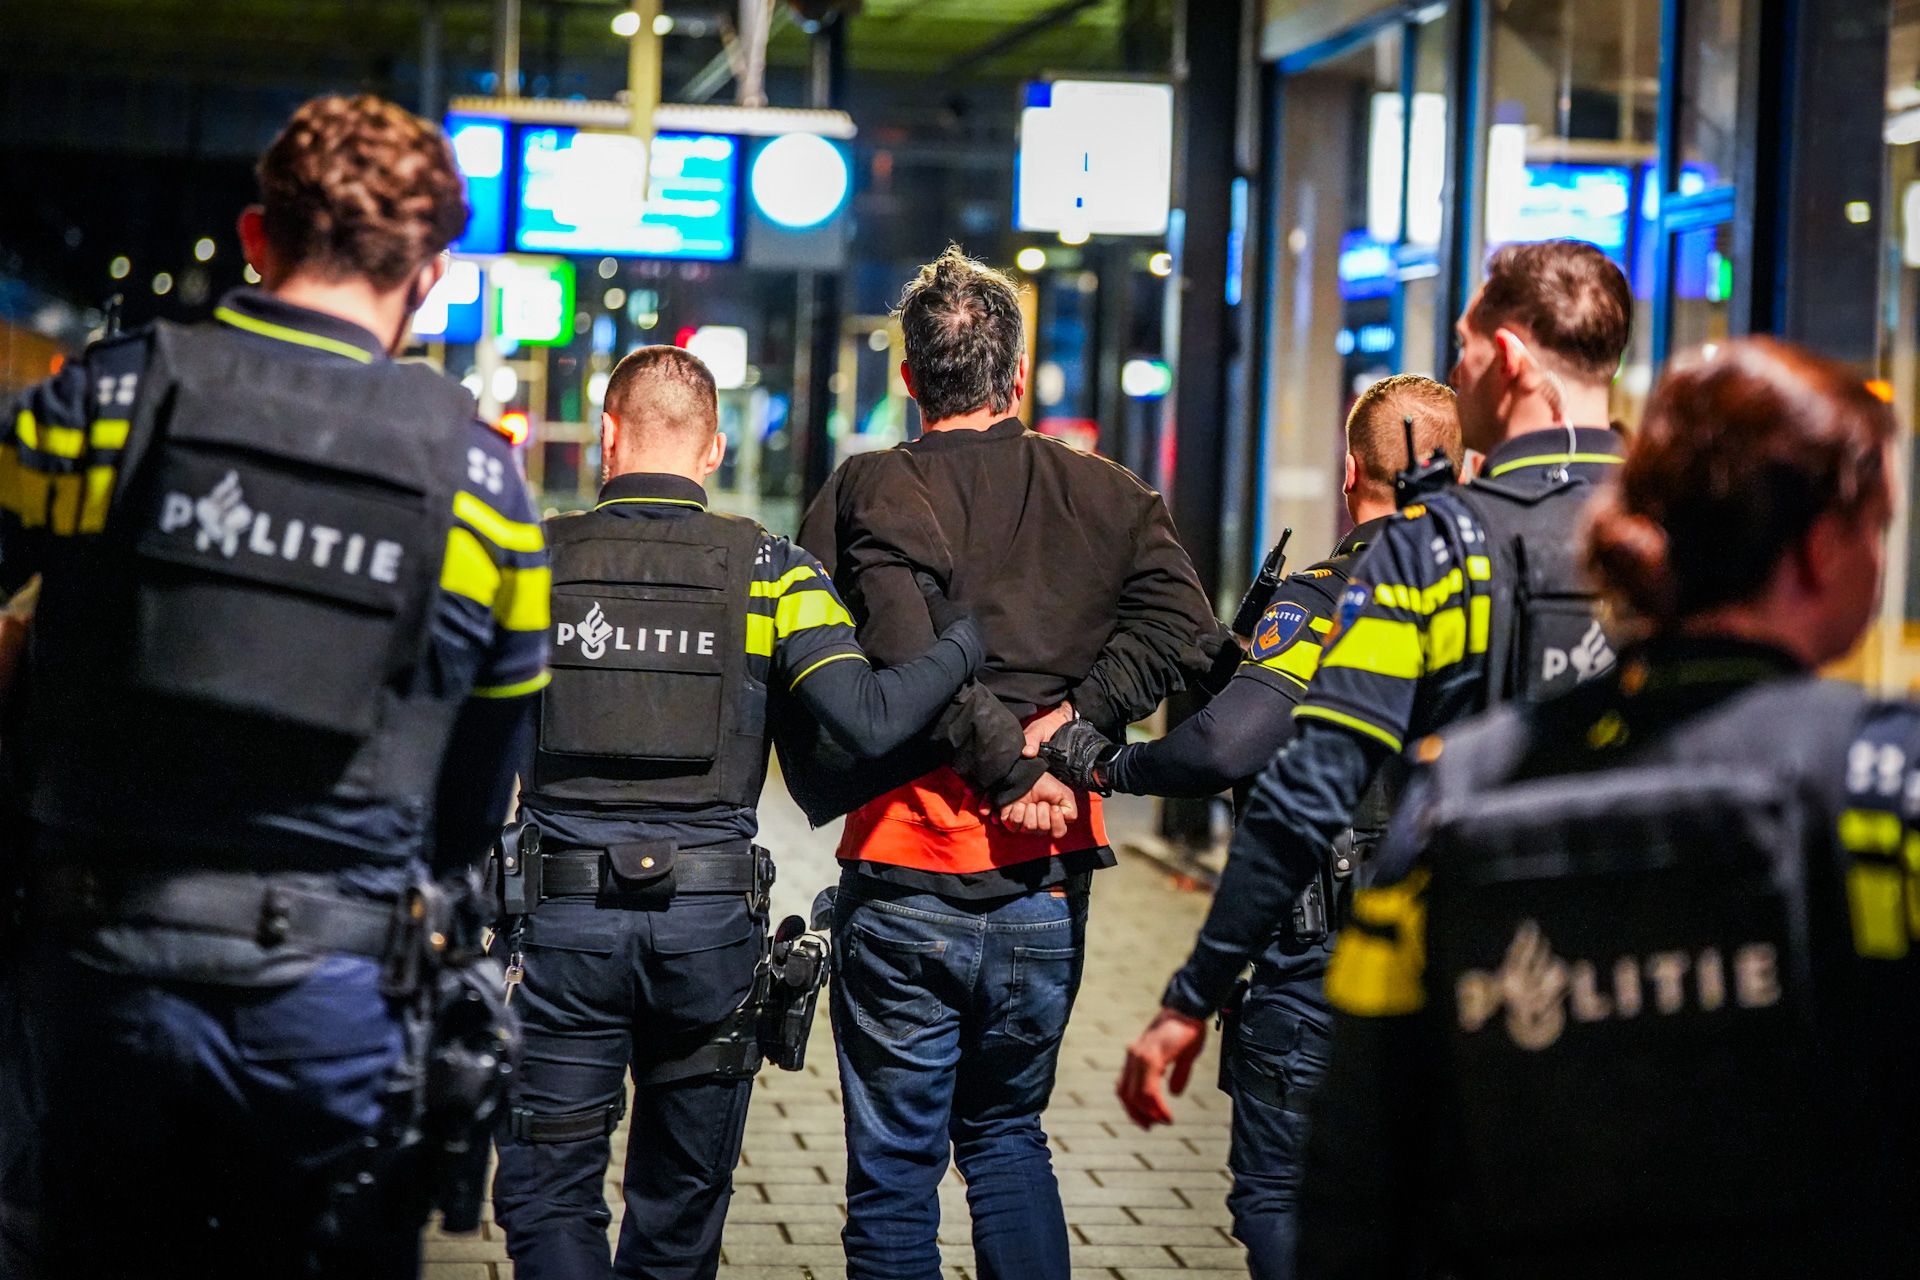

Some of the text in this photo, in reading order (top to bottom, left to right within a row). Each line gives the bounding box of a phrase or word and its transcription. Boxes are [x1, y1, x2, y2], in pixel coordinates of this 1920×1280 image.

[160, 470, 403, 584] POLITIE
[556, 601, 715, 660] POLITIE
[1455, 918, 1781, 1050] POLITIE
